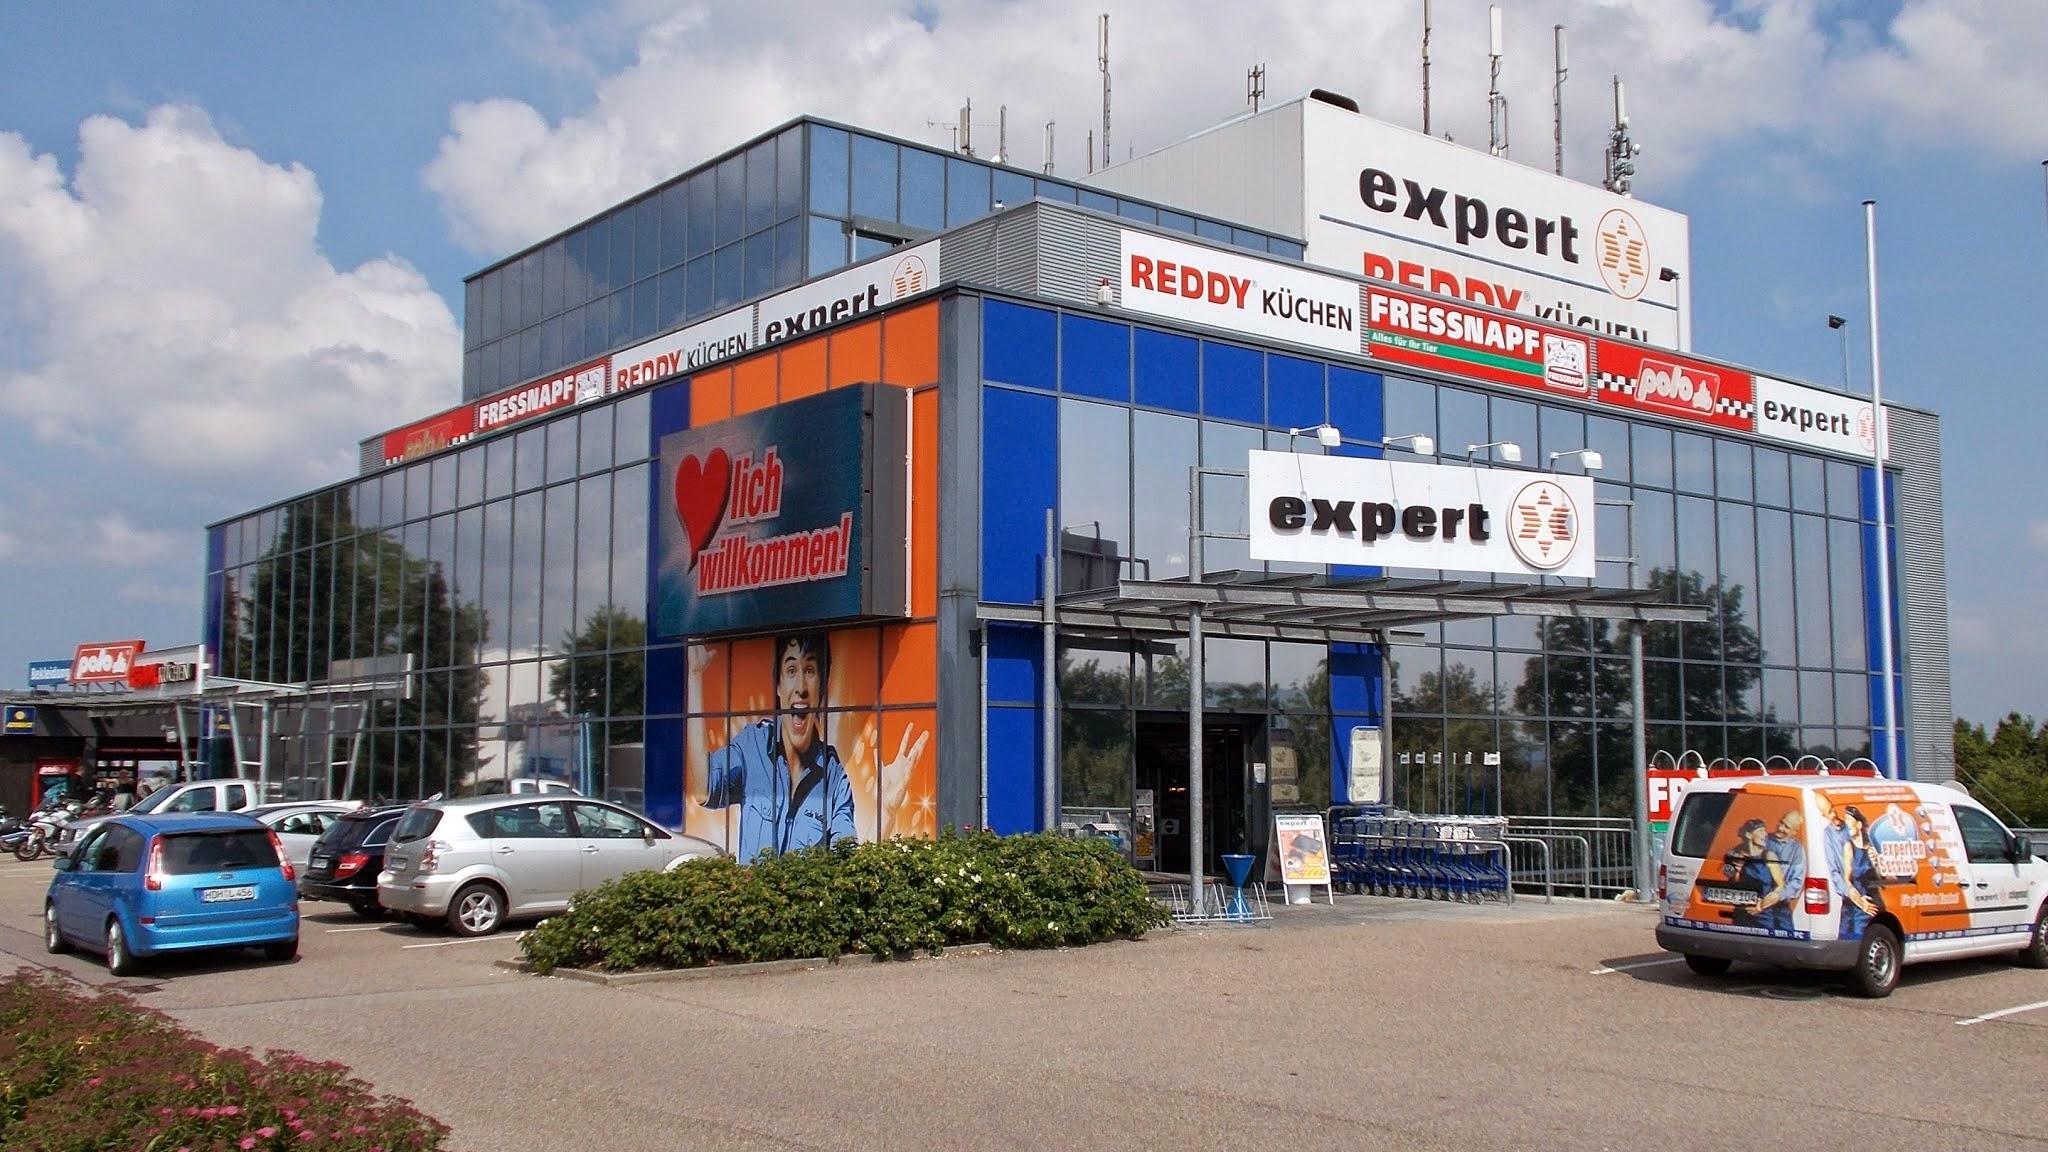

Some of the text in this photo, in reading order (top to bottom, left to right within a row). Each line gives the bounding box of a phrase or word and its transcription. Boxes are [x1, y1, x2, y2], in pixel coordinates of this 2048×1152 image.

[1359, 167, 1580, 264] expert
[1131, 254, 1353, 332] REDDY KÜCHEN
[1370, 293, 1541, 356] FRESSNAPF
[1372, 331, 1438, 353] Alles für Ihr Tier
[617, 332, 748, 393] REDDY KÜCHEN
[1636, 365, 1694, 402] polo
[479, 375, 575, 428] FRESSNAPF
[1764, 399, 1850, 436] expert
[731, 453, 782, 520] lich
[1269, 496, 1490, 542] expert
[700, 517, 851, 592] willkommen!
[77, 649, 114, 679] polo
[1882, 841, 1925, 857] experten
